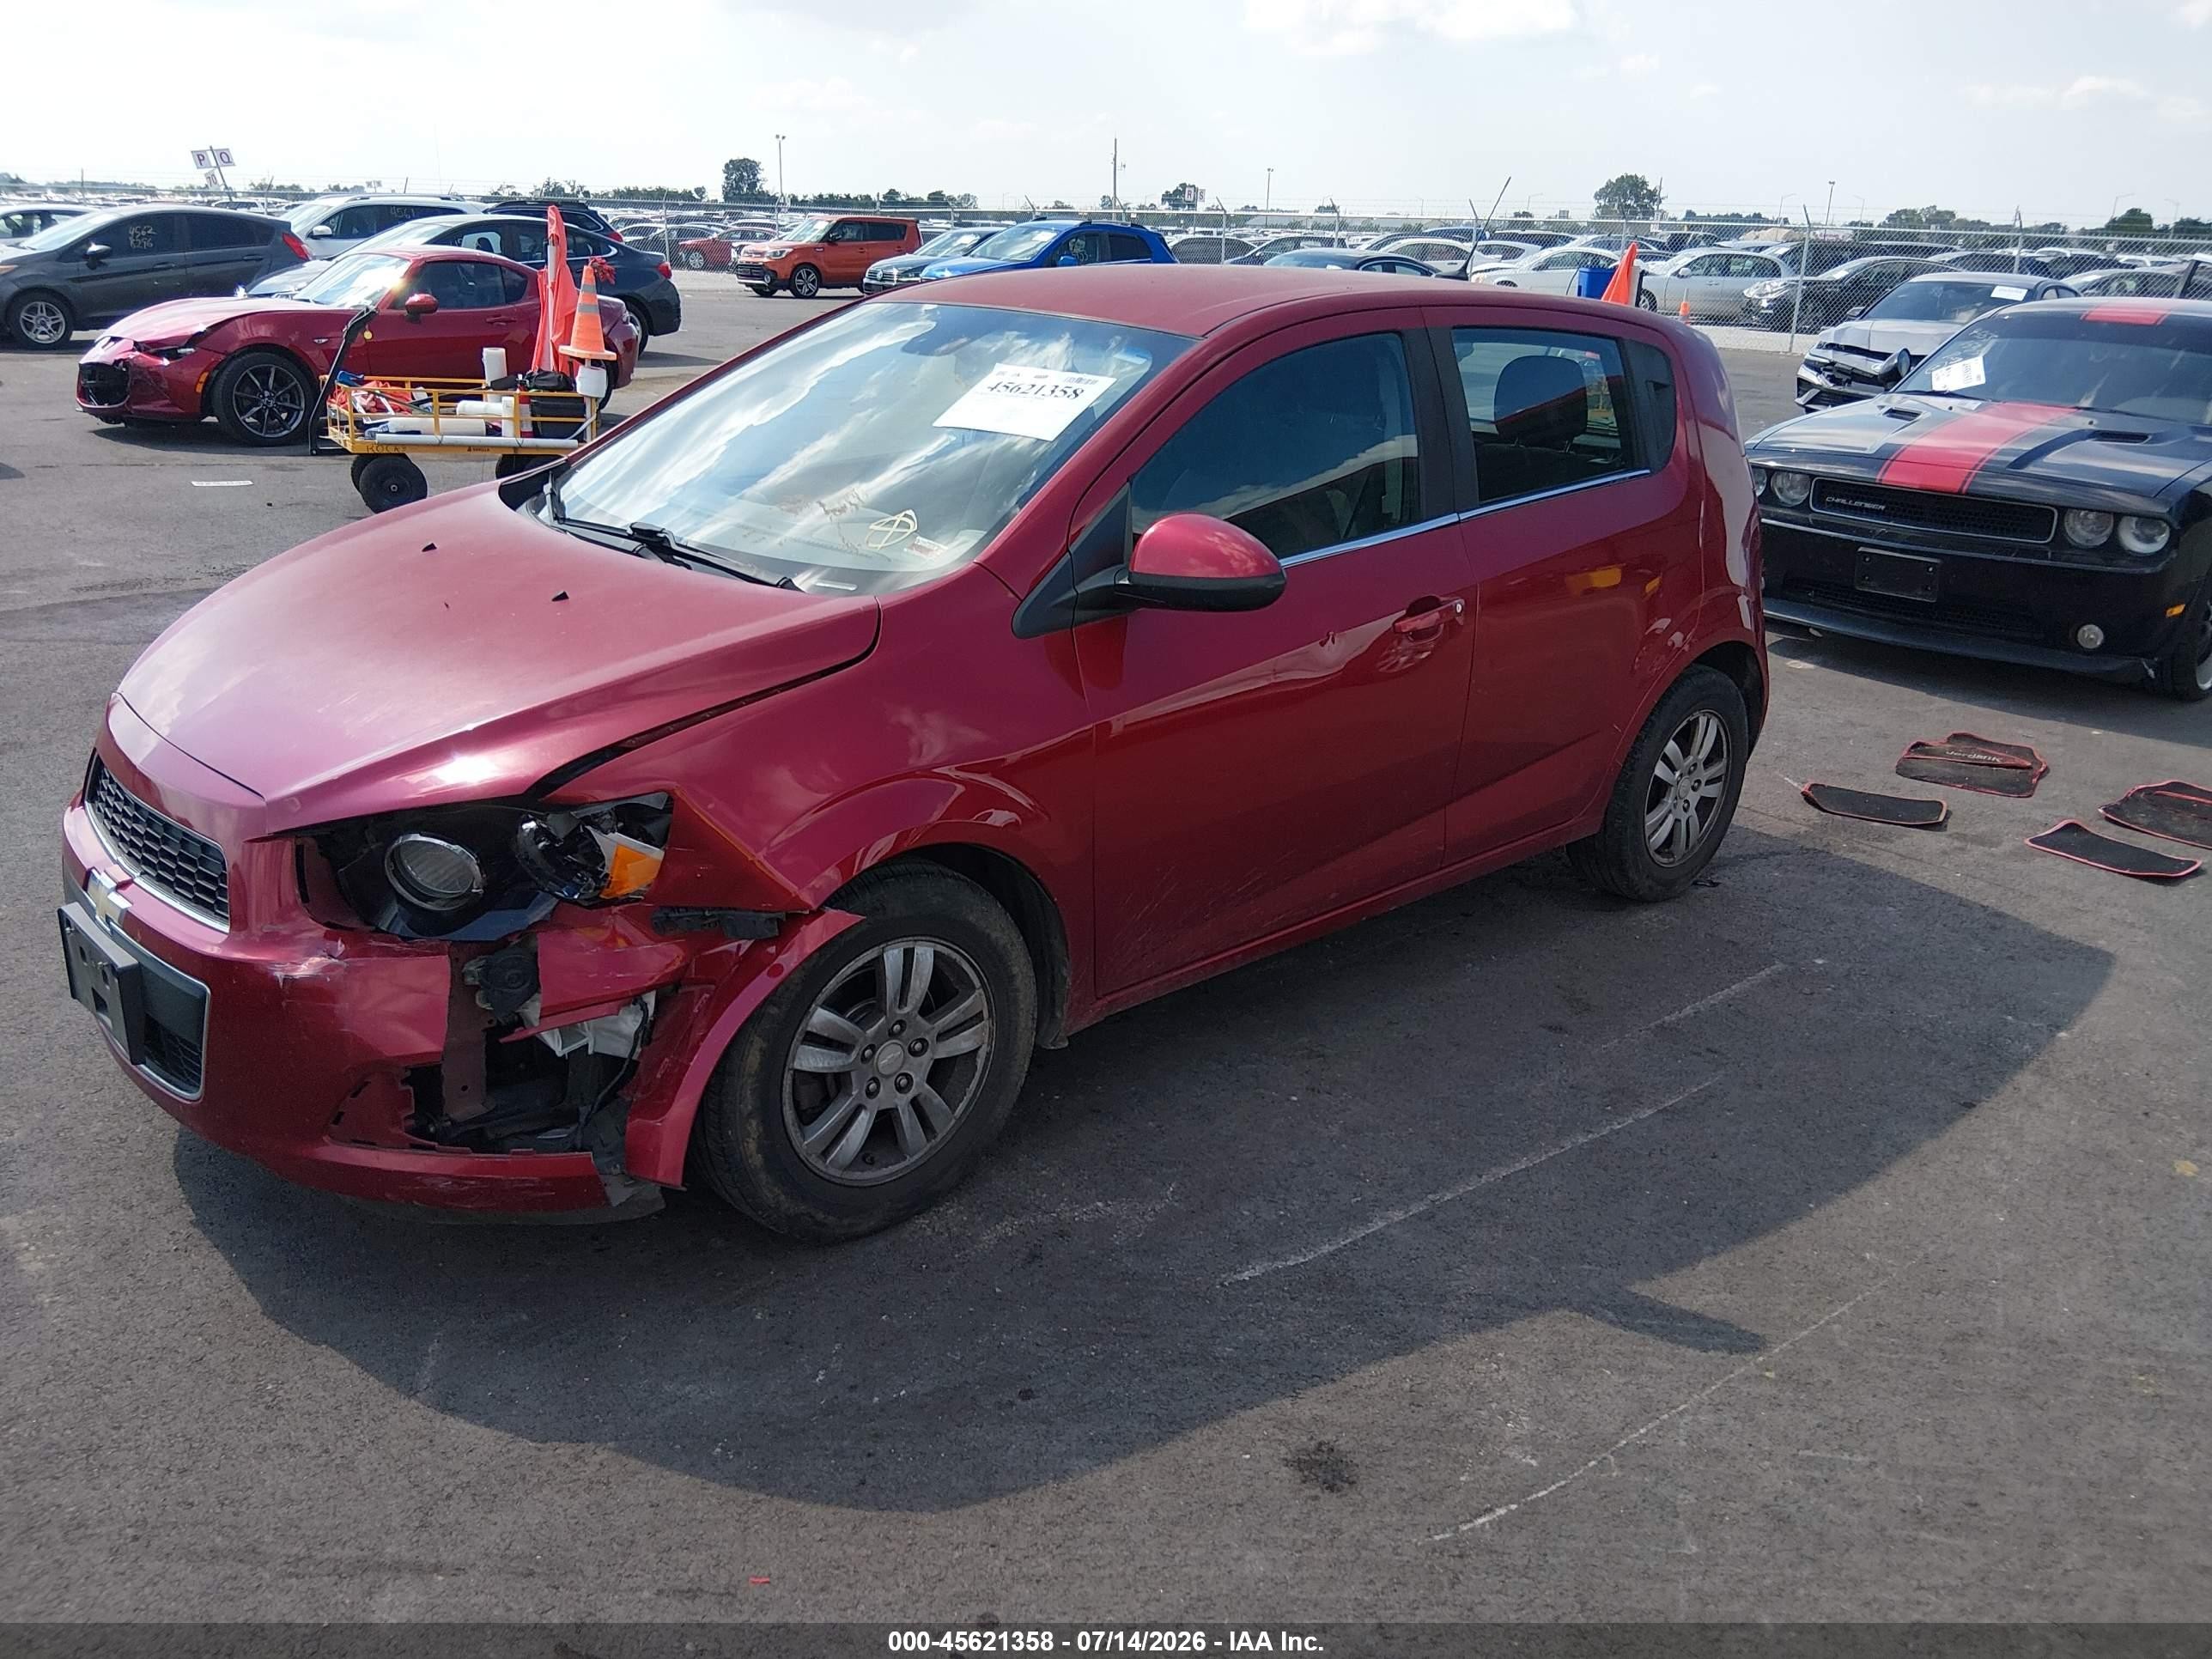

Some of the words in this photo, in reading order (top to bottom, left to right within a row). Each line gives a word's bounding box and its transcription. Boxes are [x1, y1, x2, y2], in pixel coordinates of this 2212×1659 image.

[197, 153, 205, 166] P
[219, 151, 233, 164] Q
[987, 380, 1085, 400] 45621358
